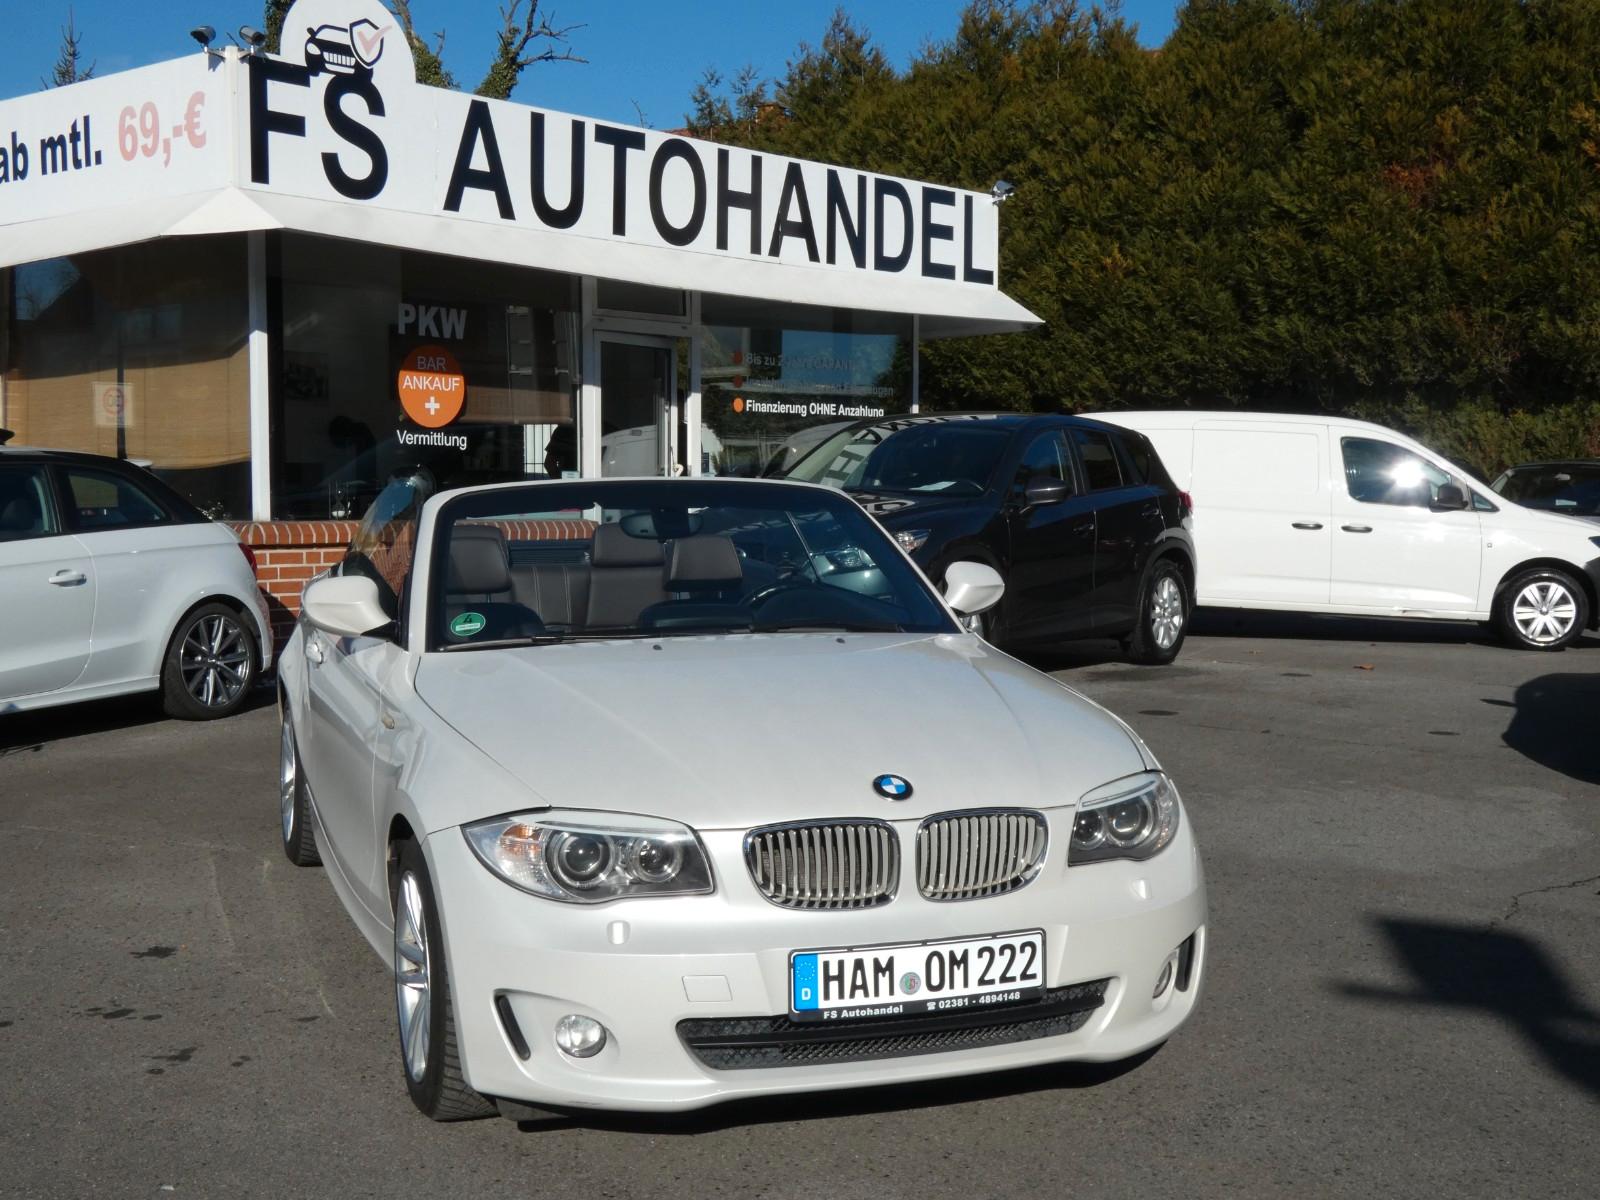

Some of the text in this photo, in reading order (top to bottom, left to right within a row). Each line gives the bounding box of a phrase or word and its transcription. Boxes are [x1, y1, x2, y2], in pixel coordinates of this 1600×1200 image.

[40, 115, 102, 175] mtl.
[119, 91, 206, 168] 69,-€
[249, 56, 995, 285] FS AUTOHANDEL
[398, 303, 467, 340] PKW
[416, 356, 446, 371] BAR
[402, 375, 461, 392] ANKAUF
[746, 400, 807, 417] Finanzierung
[809, 402, 837, 416] OHNE
[397, 429, 467, 451] Vermittlung
[801, 941, 1037, 1001] D HAM OM 222
[823, 1010, 838, 1019] FS
[841, 1004, 903, 1018] Autohandel
[938, 998, 969, 1009] 02381
[978, 991, 1021, 1004] 4894148
